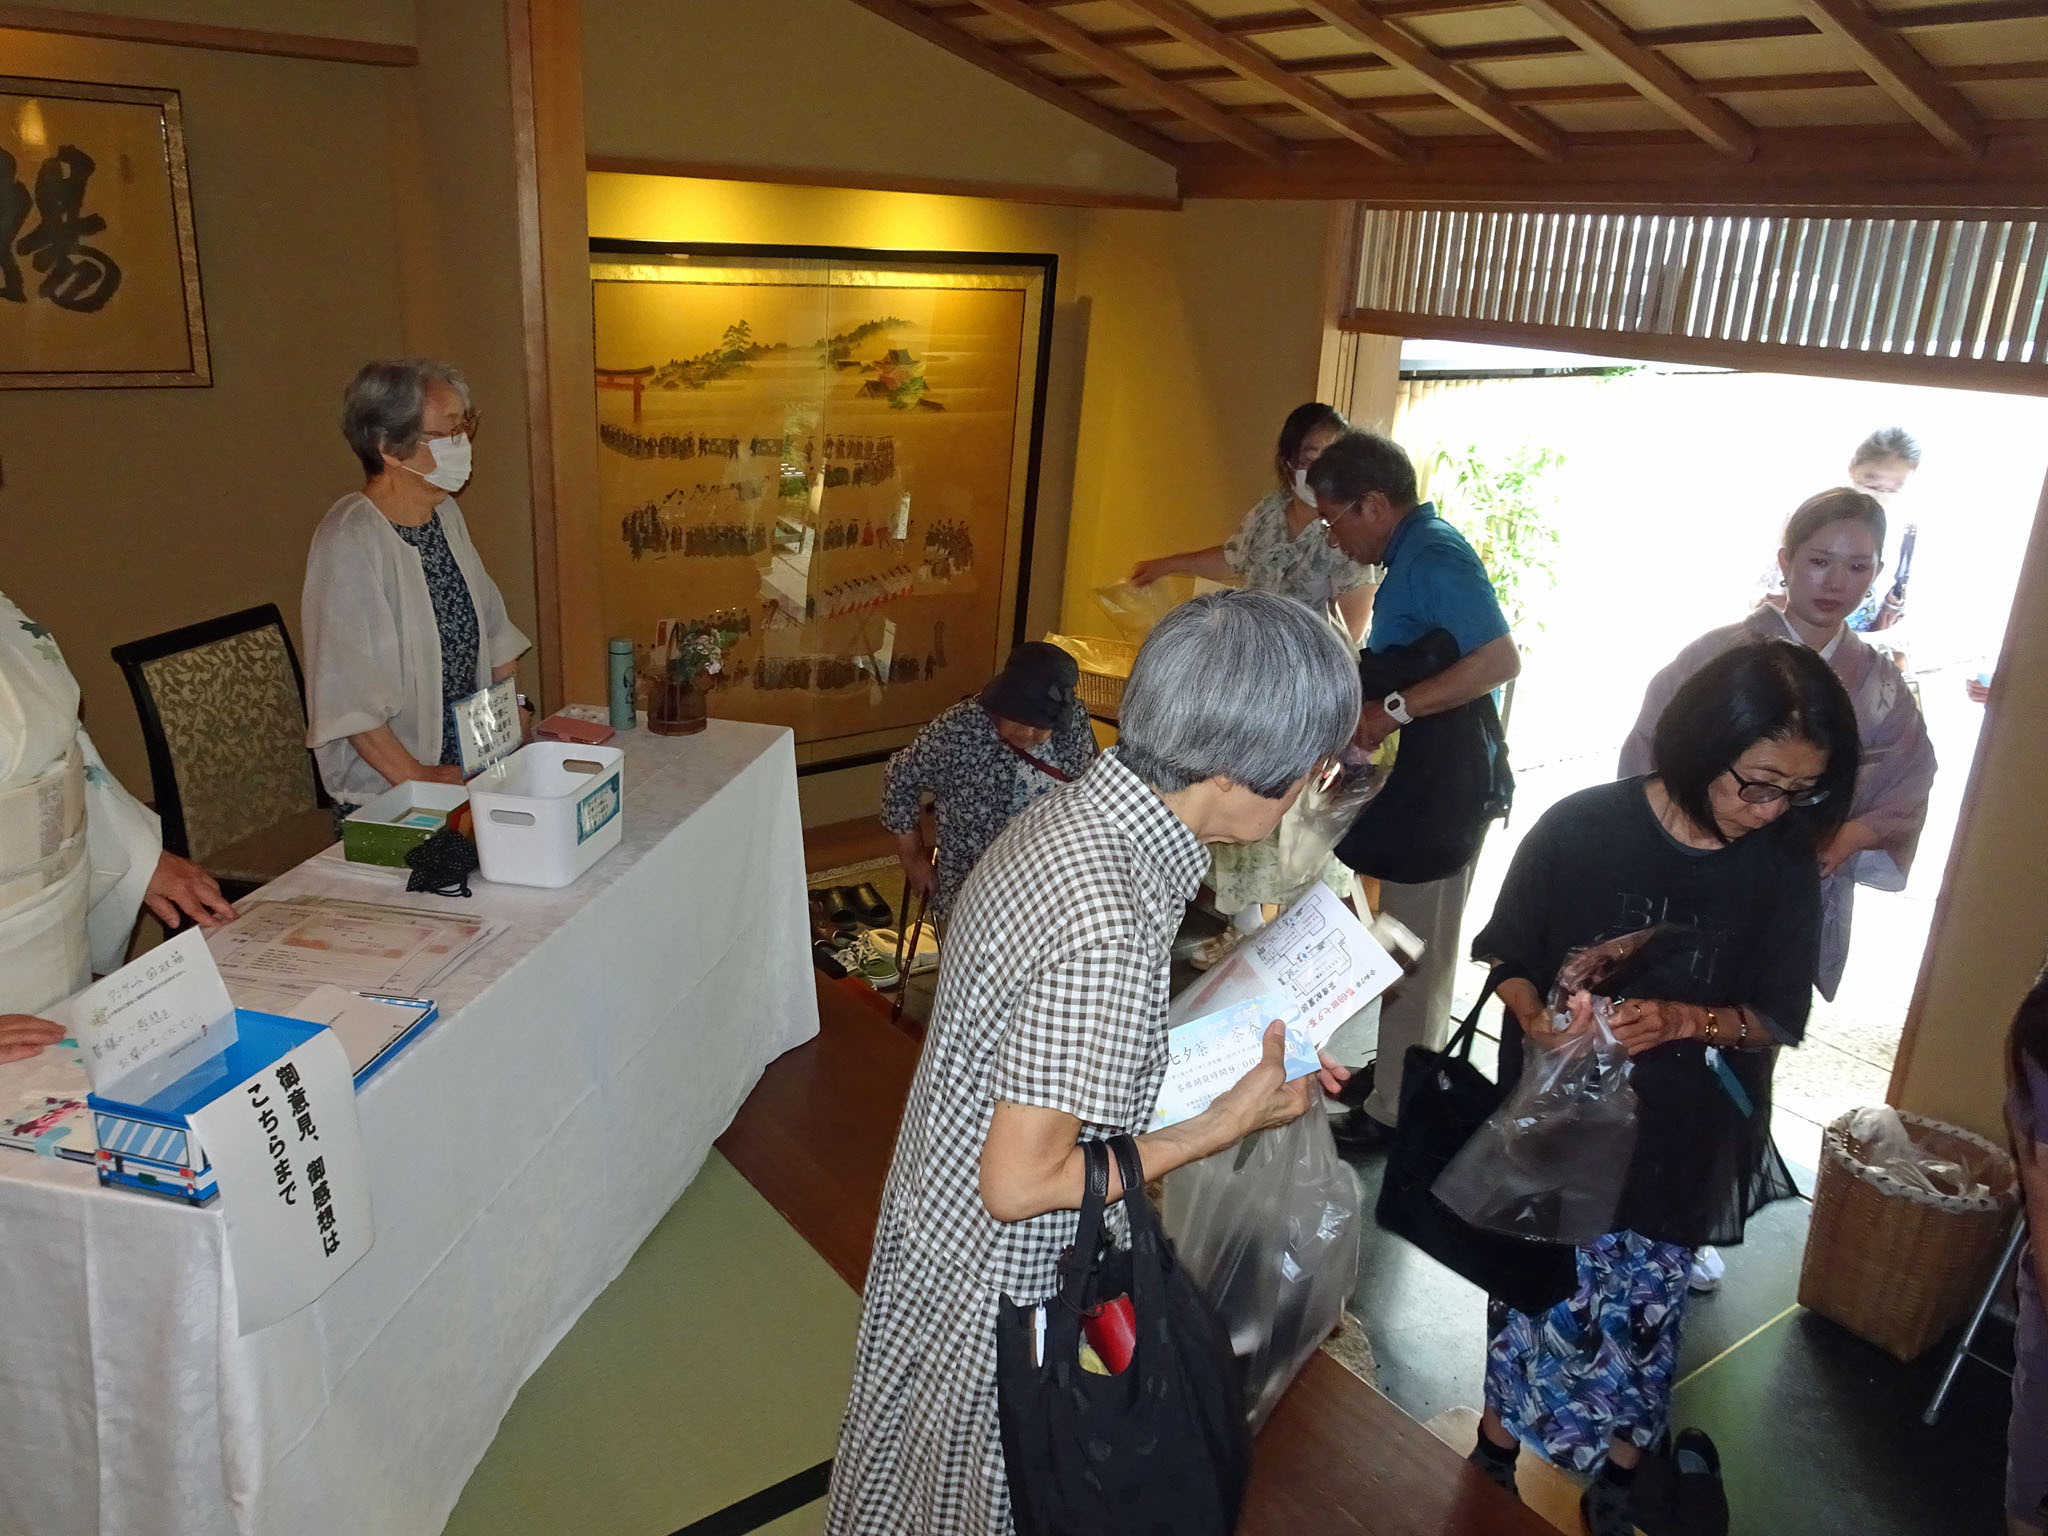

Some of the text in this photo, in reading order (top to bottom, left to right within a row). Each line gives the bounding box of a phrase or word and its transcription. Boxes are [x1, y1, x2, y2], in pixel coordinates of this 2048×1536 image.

[247, 1083, 297, 1206] こちらまで
